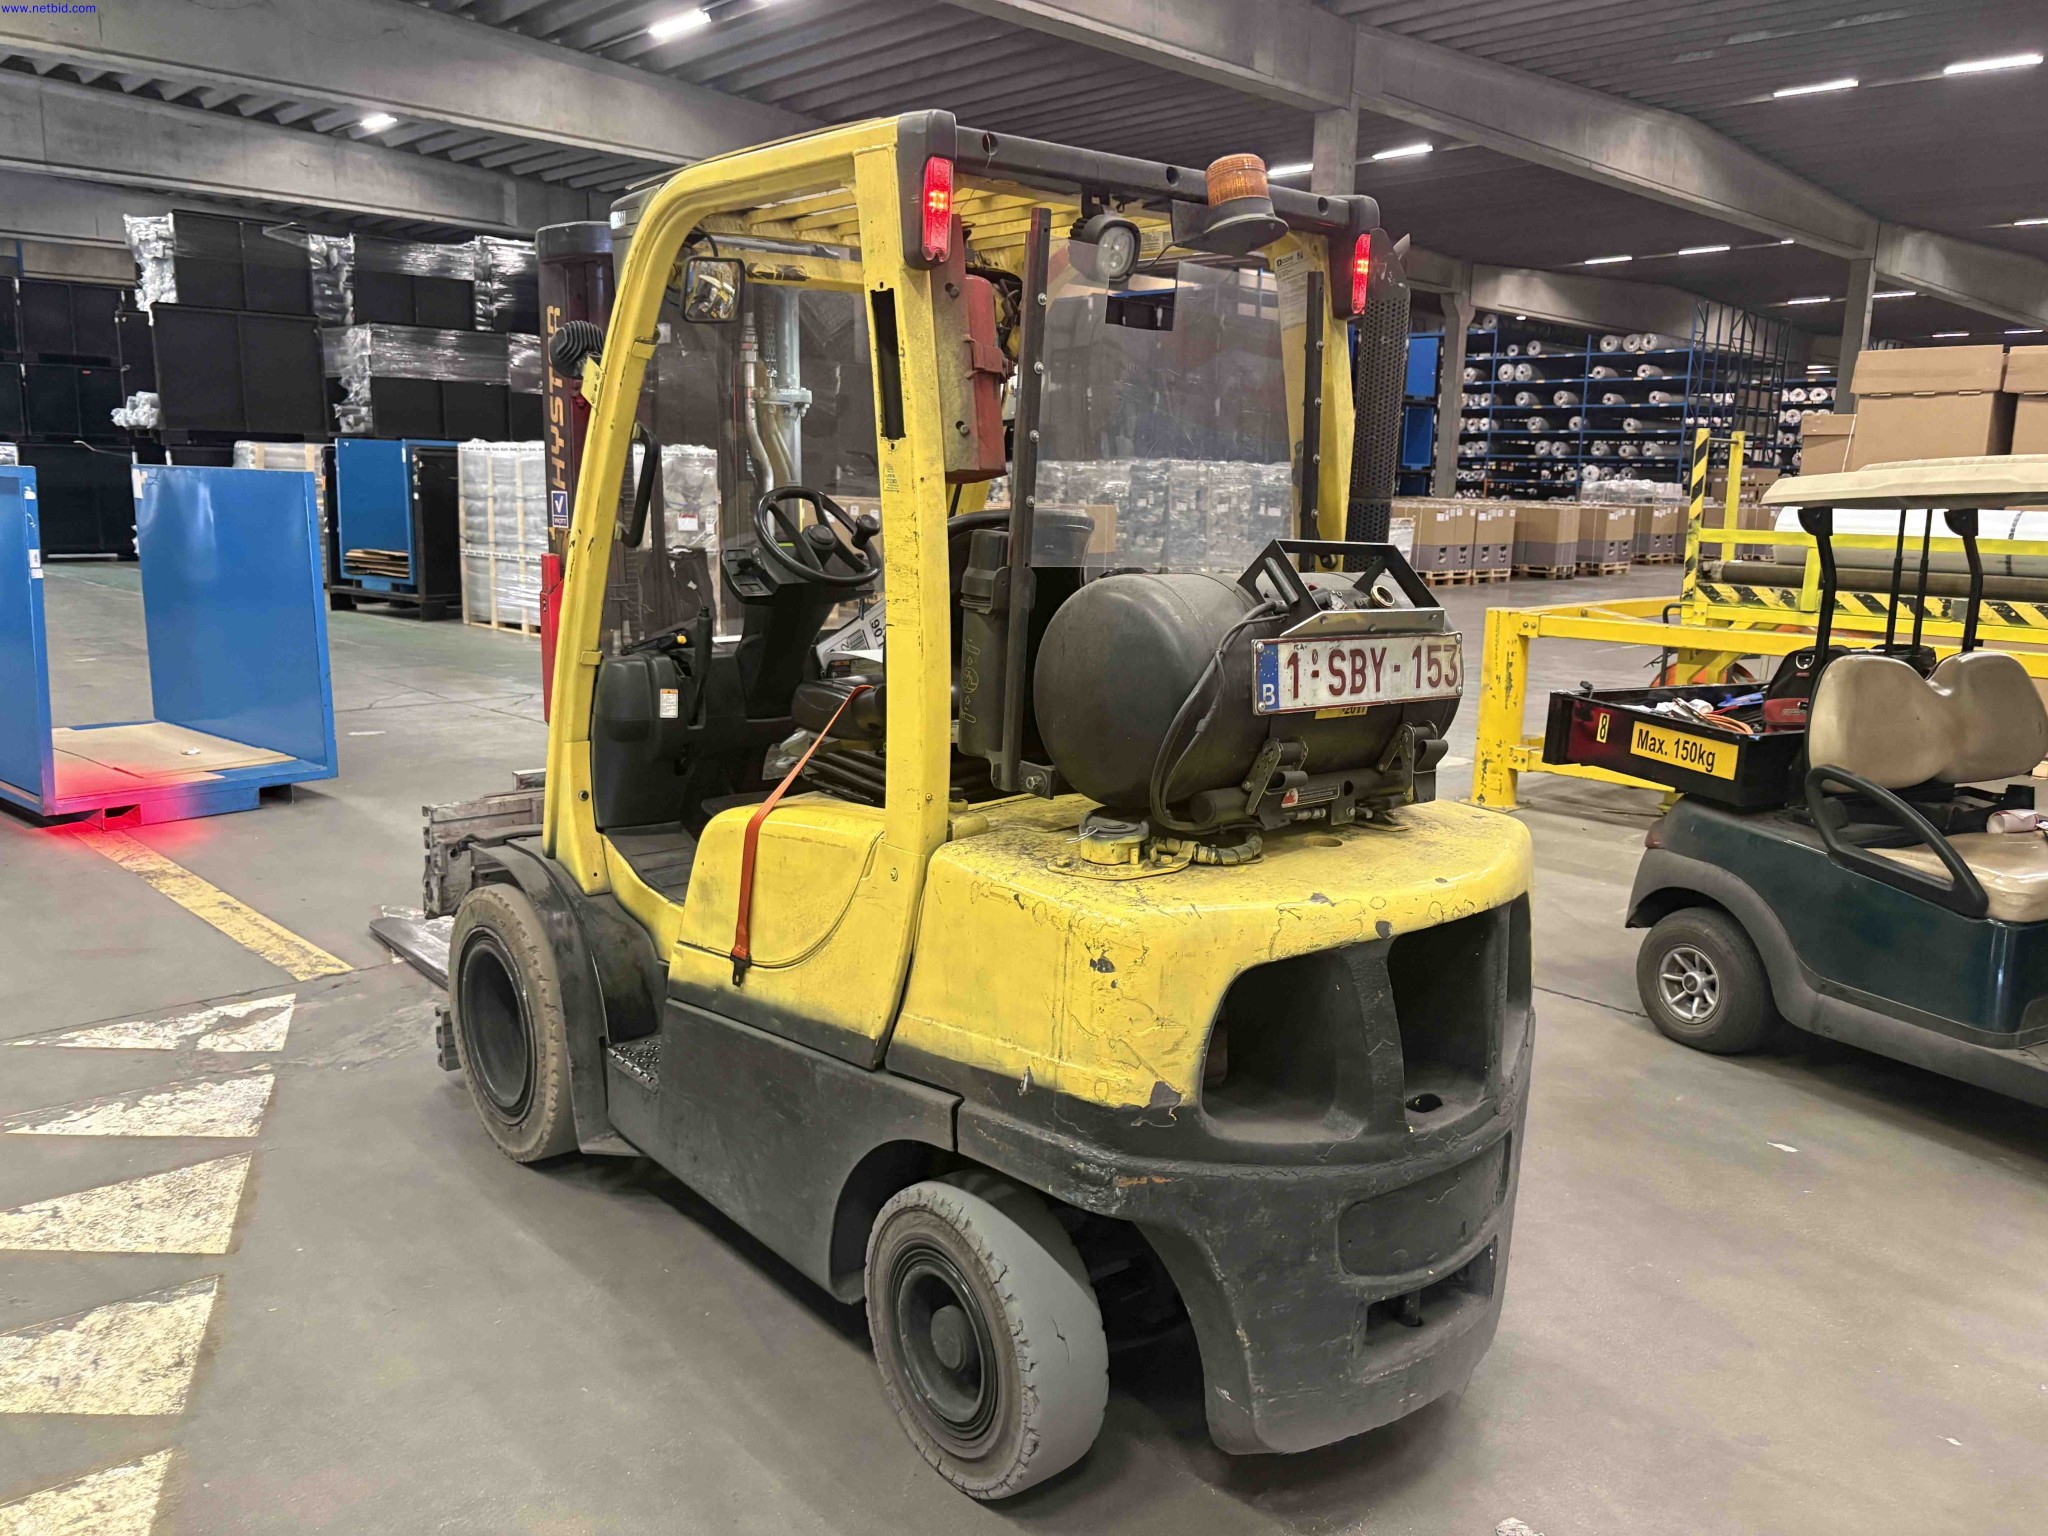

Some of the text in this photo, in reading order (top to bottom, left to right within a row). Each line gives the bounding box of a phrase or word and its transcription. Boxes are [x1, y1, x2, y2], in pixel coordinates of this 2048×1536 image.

[546, 305, 565, 489] HYSTR
[1262, 684, 1275, 706] B
[1599, 714, 1608, 740] 8
[1637, 729, 1716, 773] Max. 150kg
